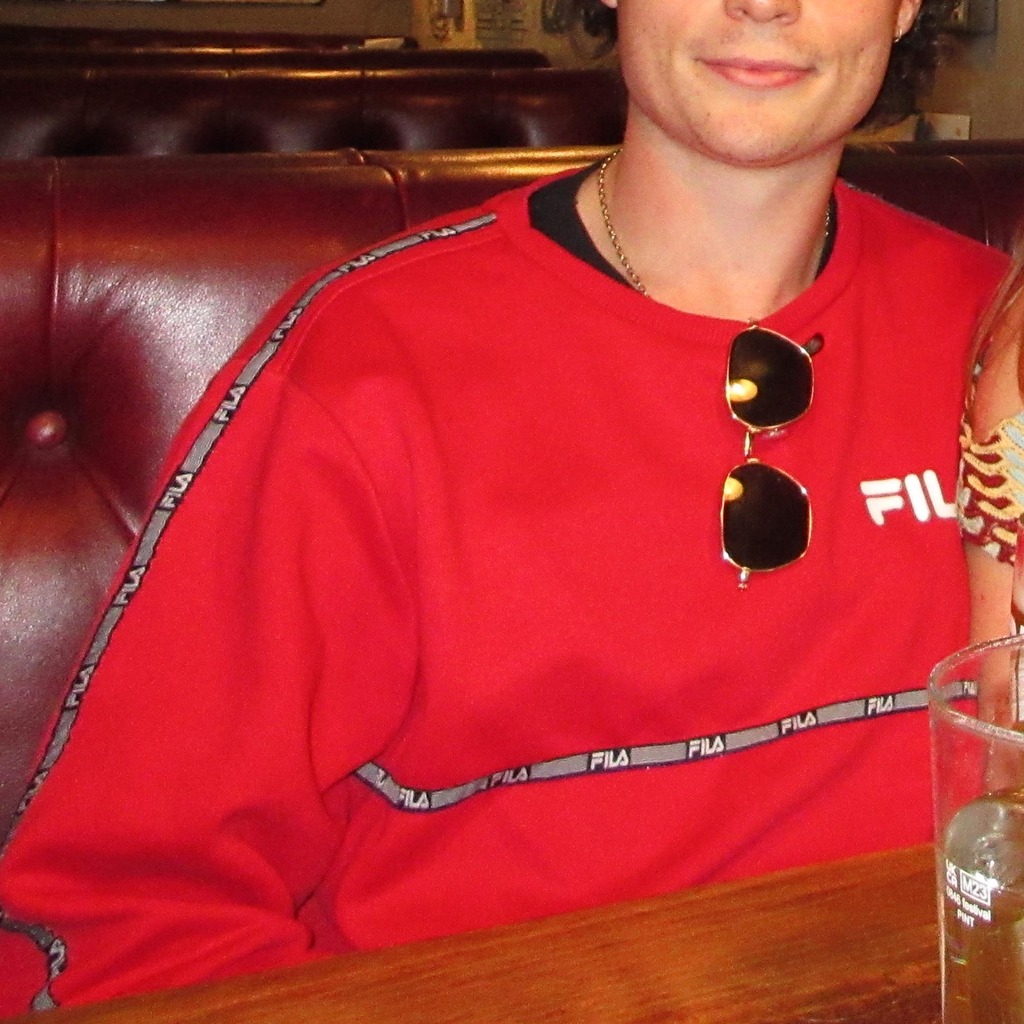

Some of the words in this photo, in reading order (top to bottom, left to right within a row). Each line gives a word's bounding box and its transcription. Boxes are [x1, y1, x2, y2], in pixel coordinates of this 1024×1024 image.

[271, 307, 303, 339] FILA
[213, 385, 247, 422] FILA
[160, 473, 194, 510] FILA
[860, 469, 958, 526] FIL
[113, 566, 146, 605] FILA
[65, 664, 94, 708] FILA
[400, 788, 430, 809] FILA
[490, 766, 528, 787] FILA
[590, 748, 629, 771] FILA
[688, 735, 724, 758] FILA
[781, 711, 816, 735] FILA
[867, 694, 894, 715] FILA
[962, 873, 988, 901] M23
[957, 908, 975, 928] PINT
[962, 896, 992, 922] festival
